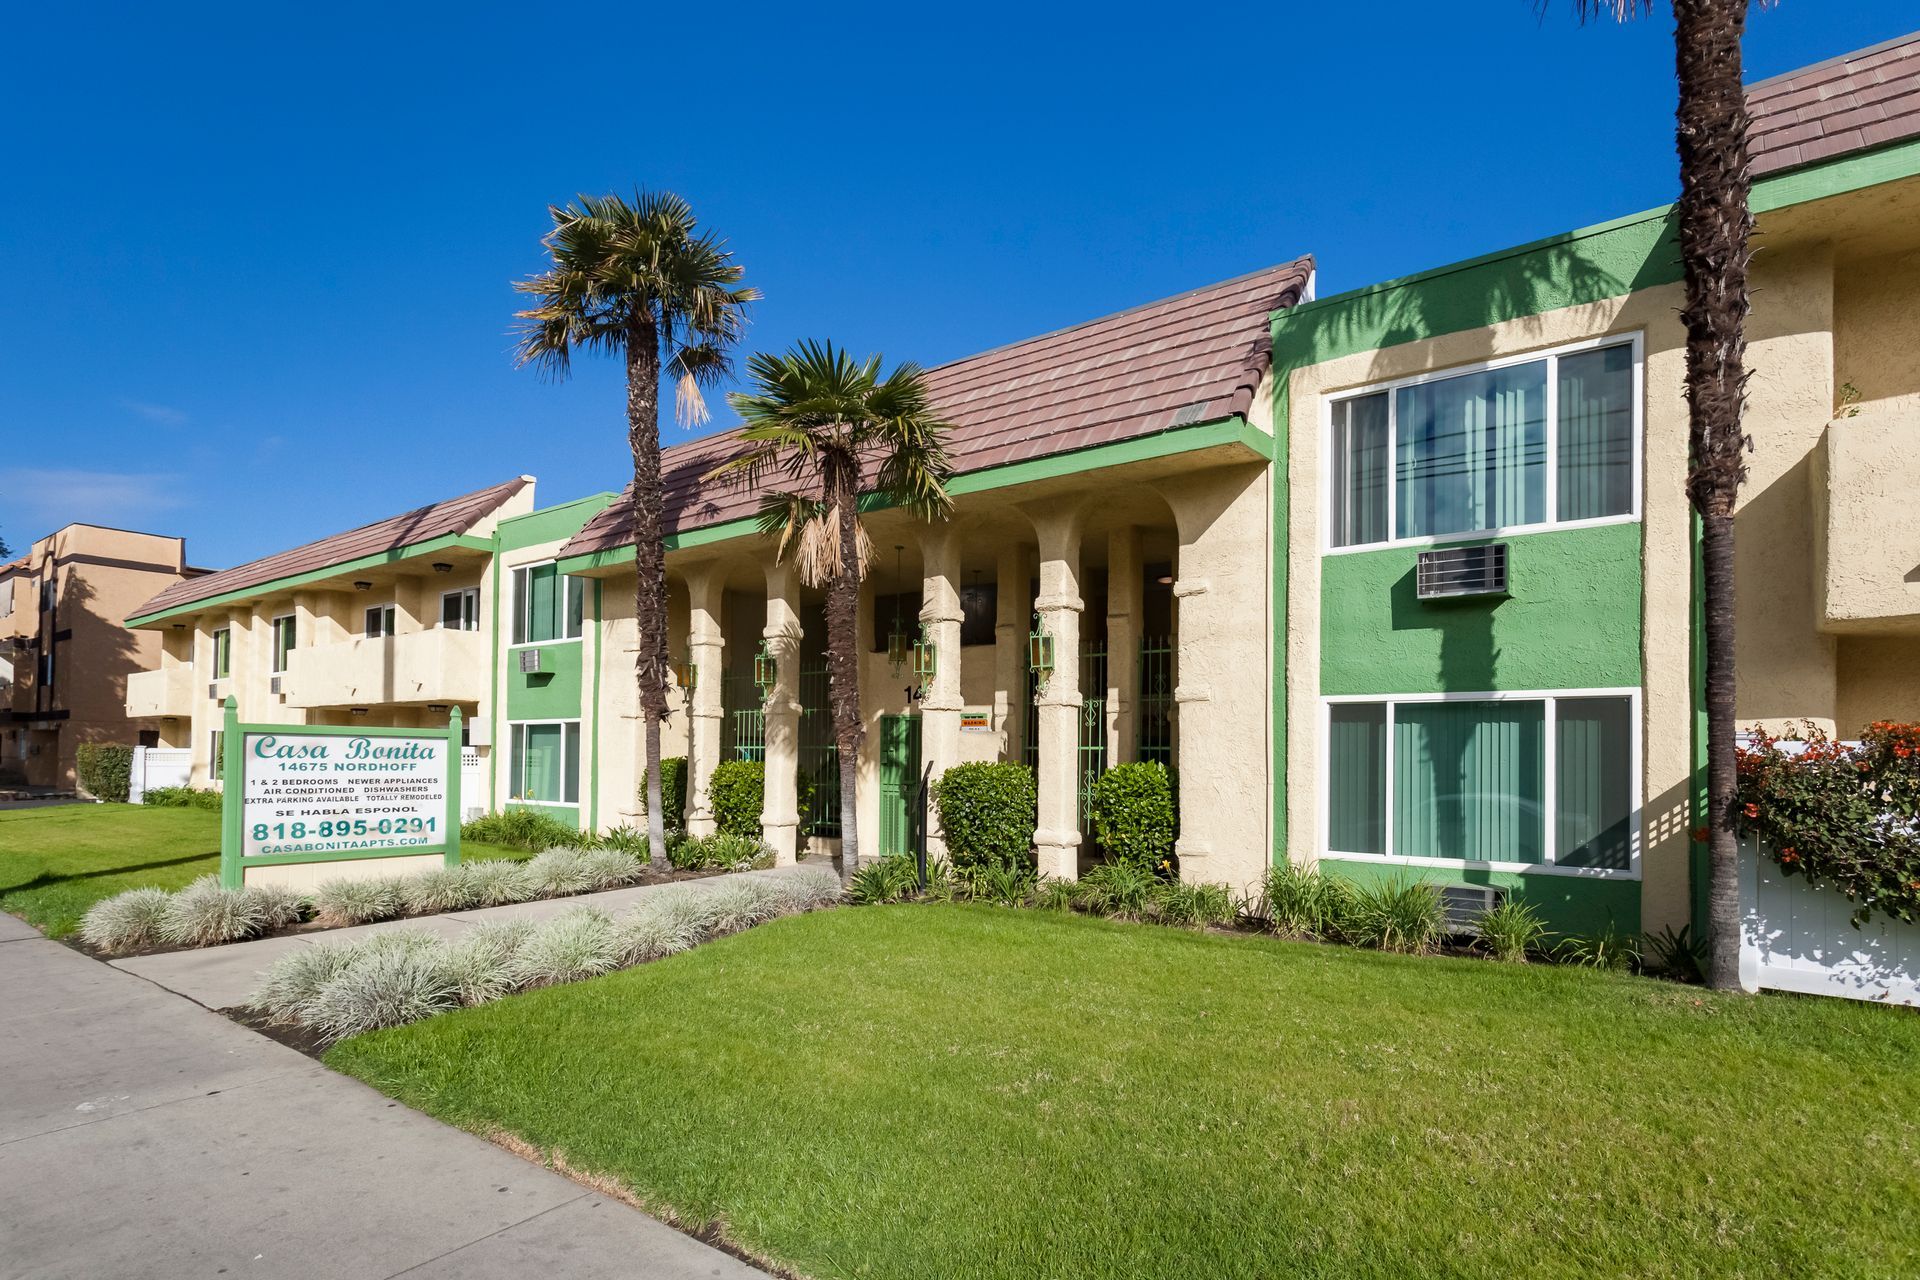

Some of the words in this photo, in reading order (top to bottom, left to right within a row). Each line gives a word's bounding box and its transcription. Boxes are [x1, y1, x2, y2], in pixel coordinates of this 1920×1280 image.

[255, 736, 329, 759] Casa
[346, 738, 436, 760] Bonita
[278, 763, 328, 771] 14675
[334, 763, 417, 771] NORDHOFF
[253, 817, 436, 841] 818-895-0291
[262, 838, 428, 854] CASABONITAAPTS.COM
